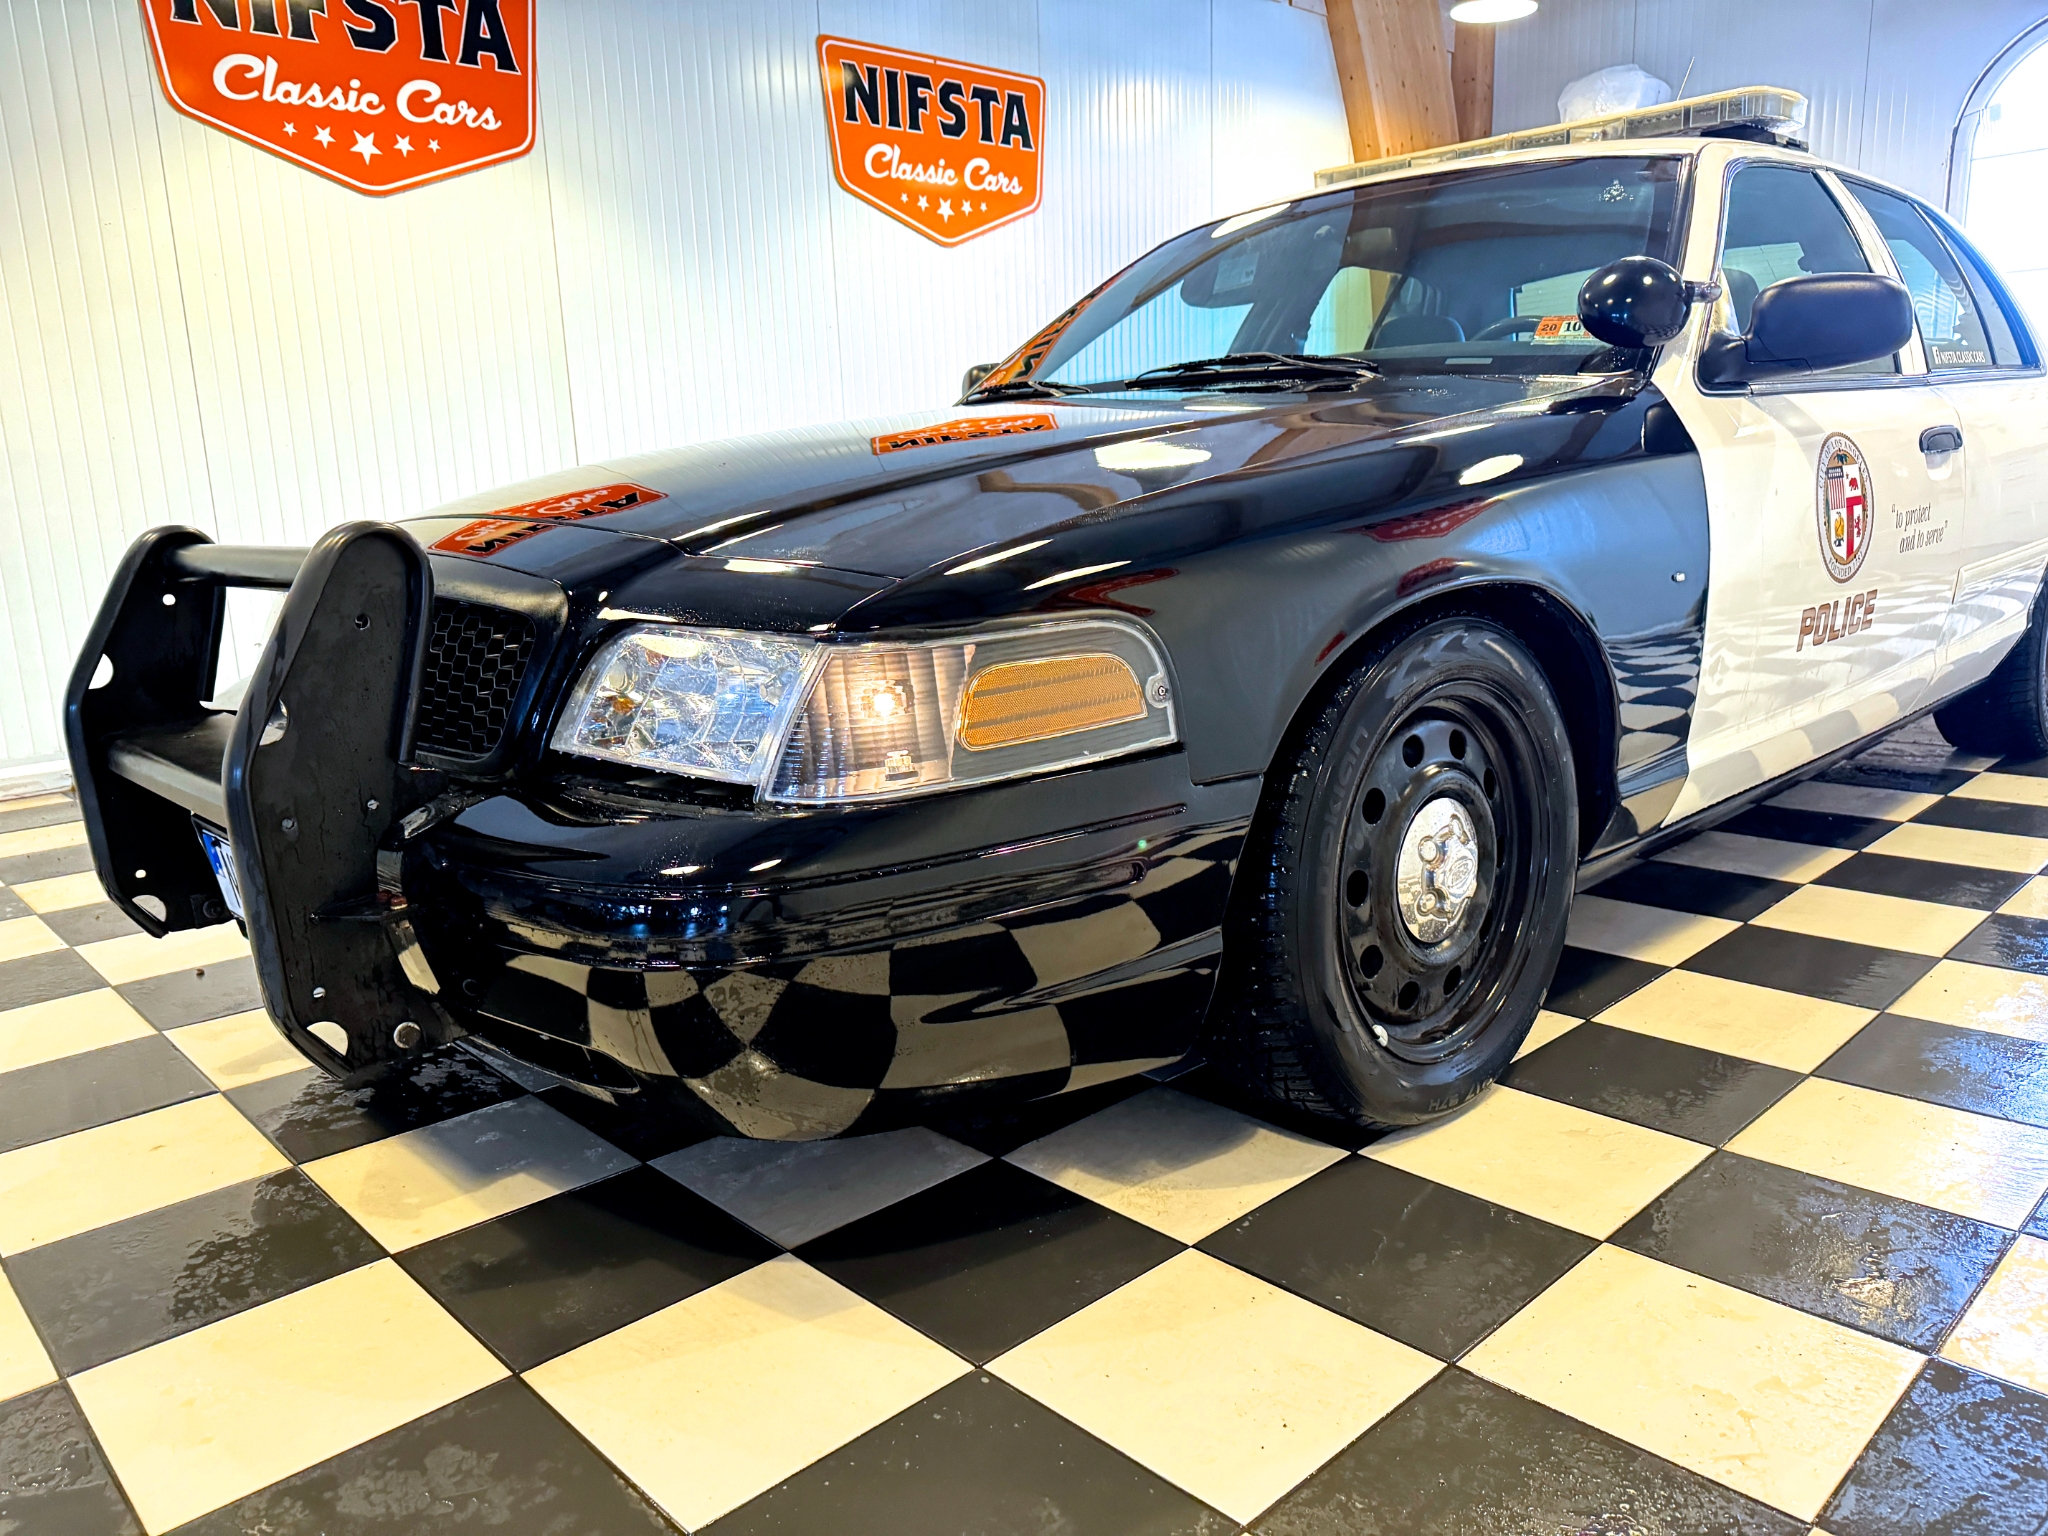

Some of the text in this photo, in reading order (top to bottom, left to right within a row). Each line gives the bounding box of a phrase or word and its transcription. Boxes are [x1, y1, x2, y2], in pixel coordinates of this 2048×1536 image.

[170, 0, 522, 75] FSTA
[212, 53, 502, 131] Classic Cars
[839, 59, 1035, 152] NIFSTA
[864, 143, 1023, 195] Classic Cars
[1541, 321, 1581, 332] 20 10
[1940, 351, 1957, 364] NIFSTA
[1956, 351, 1974, 364] CLASSIC
[1974, 351, 1986, 363] CARS
[1831, 439, 1842, 450] LOS
[1904, 502, 1931, 532] protect
[1899, 528, 1916, 553] and
[1917, 529, 1924, 548] to
[1796, 589, 1878, 652] POLICE
